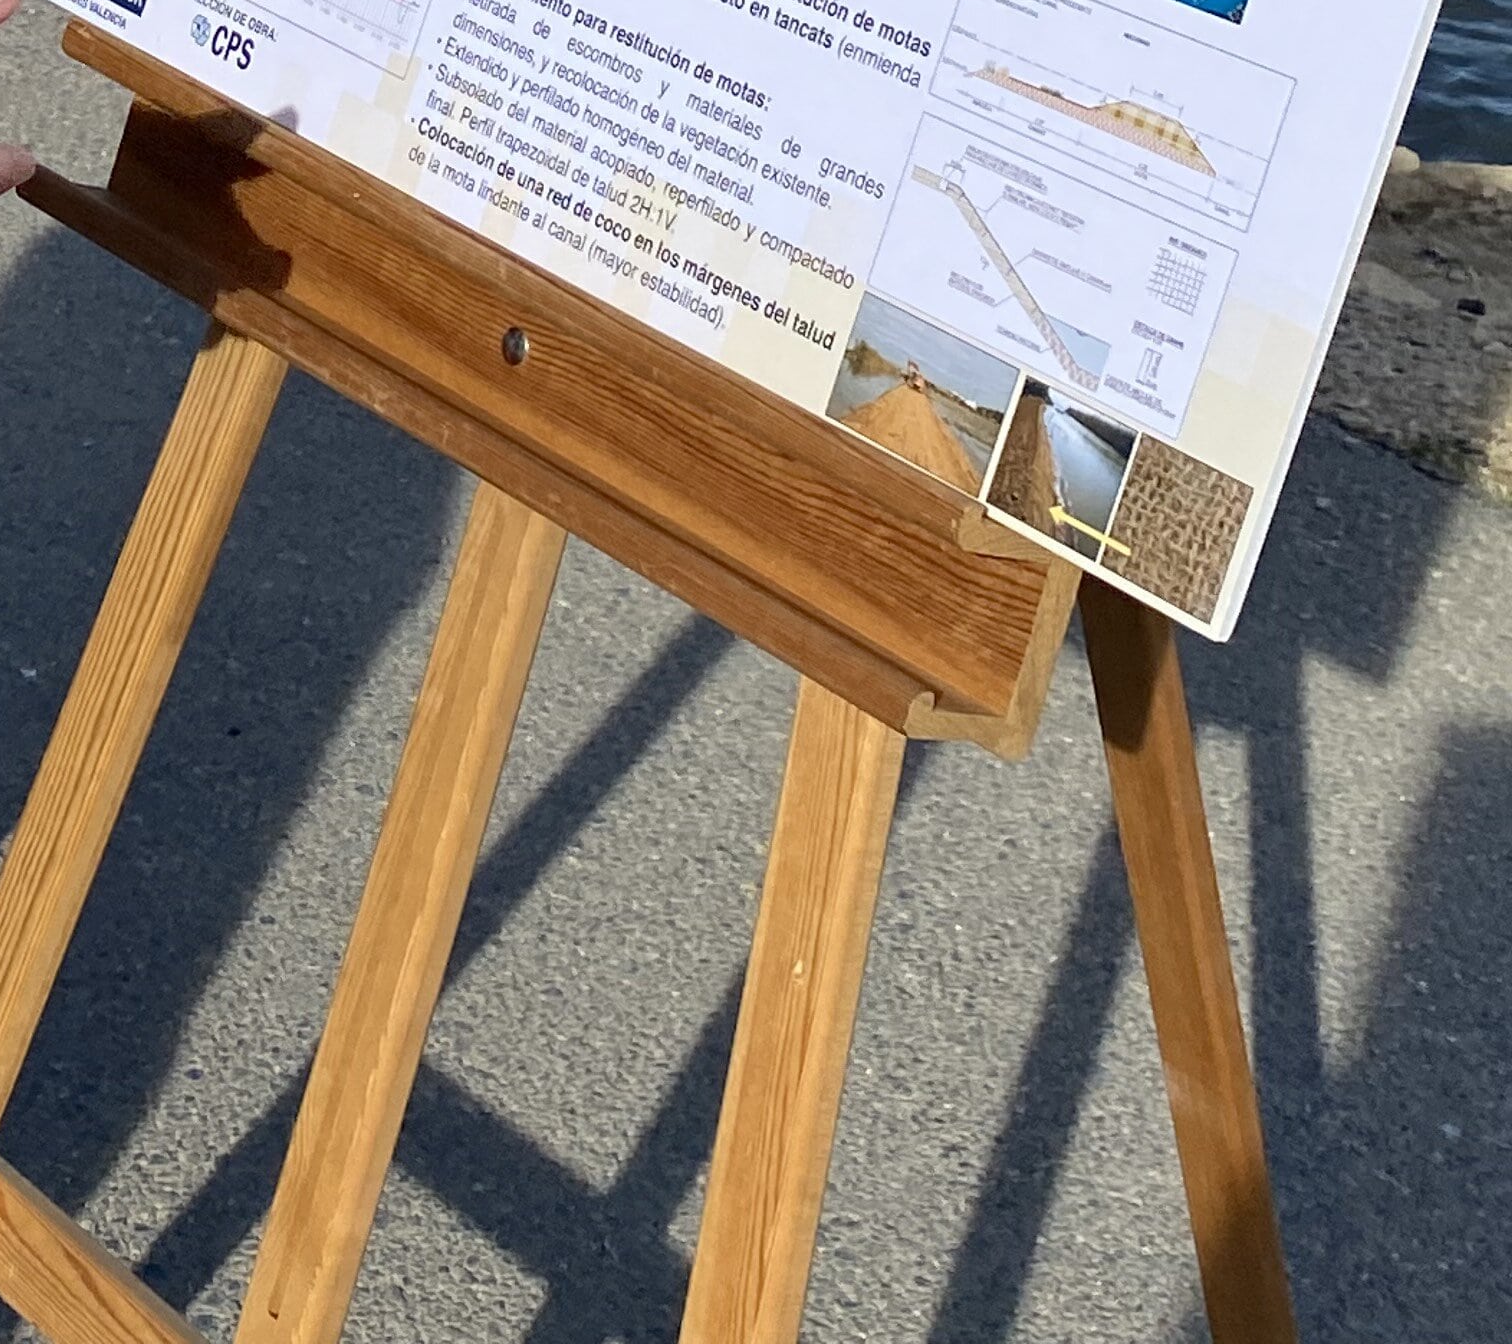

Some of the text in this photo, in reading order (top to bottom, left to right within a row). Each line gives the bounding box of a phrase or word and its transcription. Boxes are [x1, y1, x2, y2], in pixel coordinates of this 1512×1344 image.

[210, 25, 255, 70] CPS
[571, 8, 608, 35] para
[608, 25, 691, 74] restitución
[692, 61, 714, 84] de
[715, 73, 772, 112] motas:
